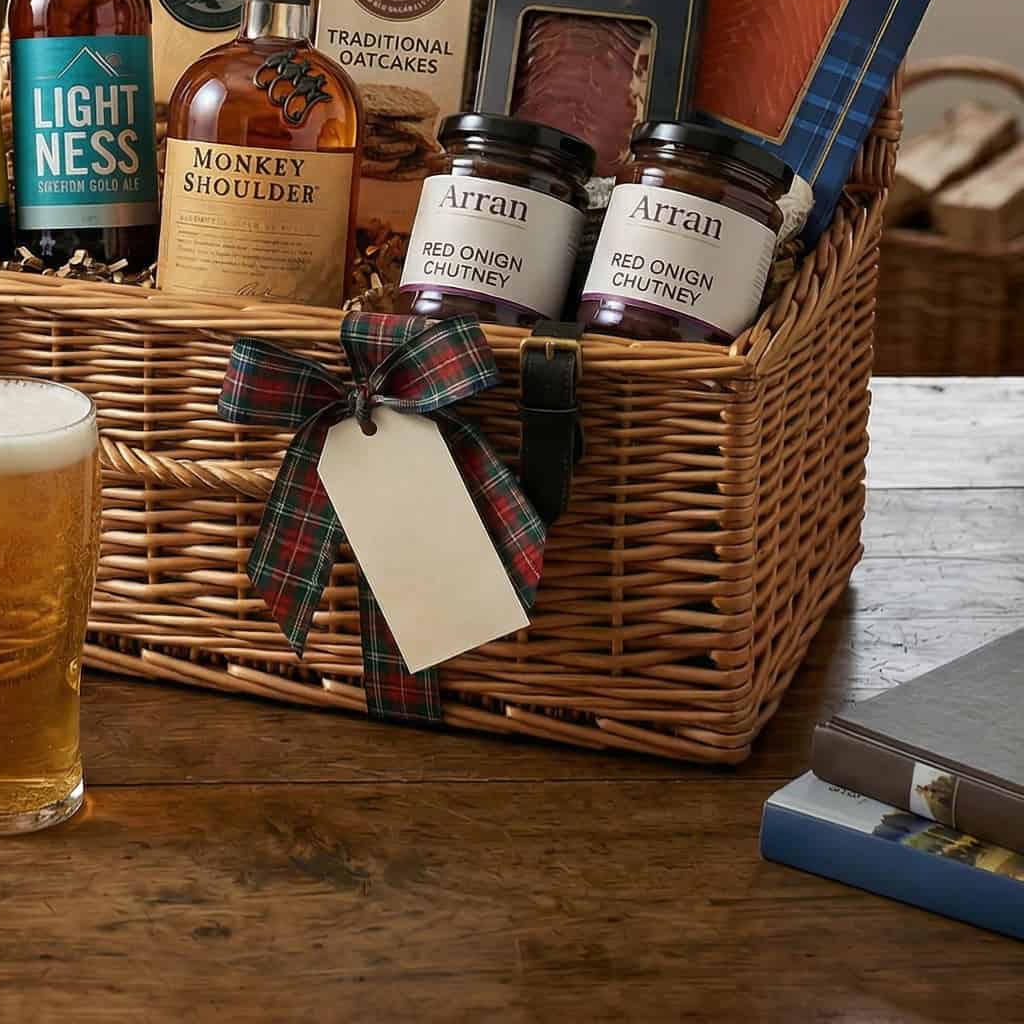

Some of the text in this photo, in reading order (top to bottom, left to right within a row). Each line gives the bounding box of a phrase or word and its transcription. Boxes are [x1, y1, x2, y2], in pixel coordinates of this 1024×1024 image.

[327, 29, 453, 56] TRADITIONAL
[339, 50, 438, 75] OATCAKES
[33, 84, 139, 129] LIGHT
[36, 129, 139, 177] NESS
[193, 147, 305, 177] MONKEY
[88, 178, 119, 193] GOLD
[183, 171, 315, 204] SHOULDER
[439, 183, 528, 223] Arran
[628, 195, 723, 241] Arran
[422, 241, 455, 258] RED
[610, 252, 644, 271] RED
[423, 259, 510, 289] CHUTNEY
[611, 272, 701, 307] CHUTNEY
